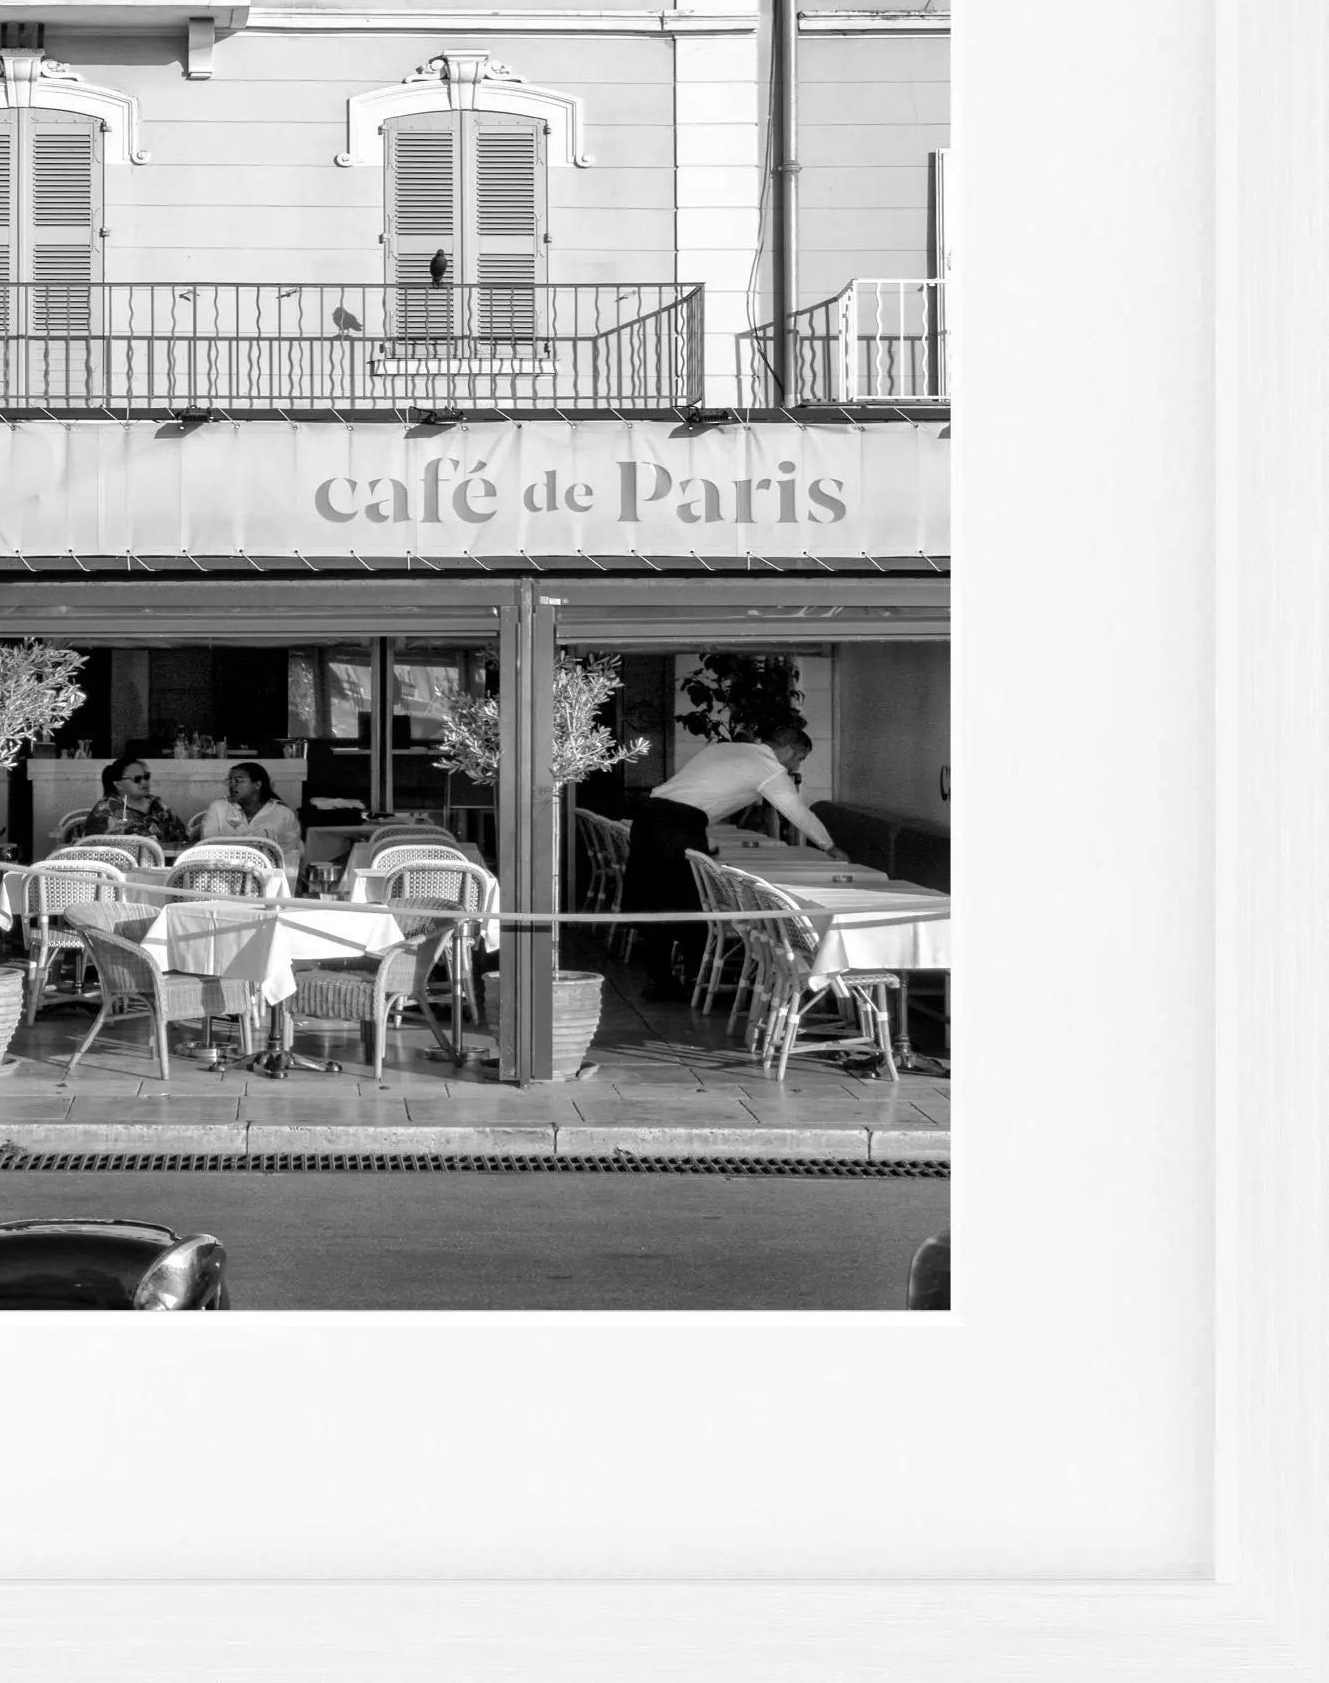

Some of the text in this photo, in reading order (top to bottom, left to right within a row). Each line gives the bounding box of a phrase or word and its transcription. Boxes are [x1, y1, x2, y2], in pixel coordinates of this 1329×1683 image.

[314, 457, 847, 524] café de Paris
